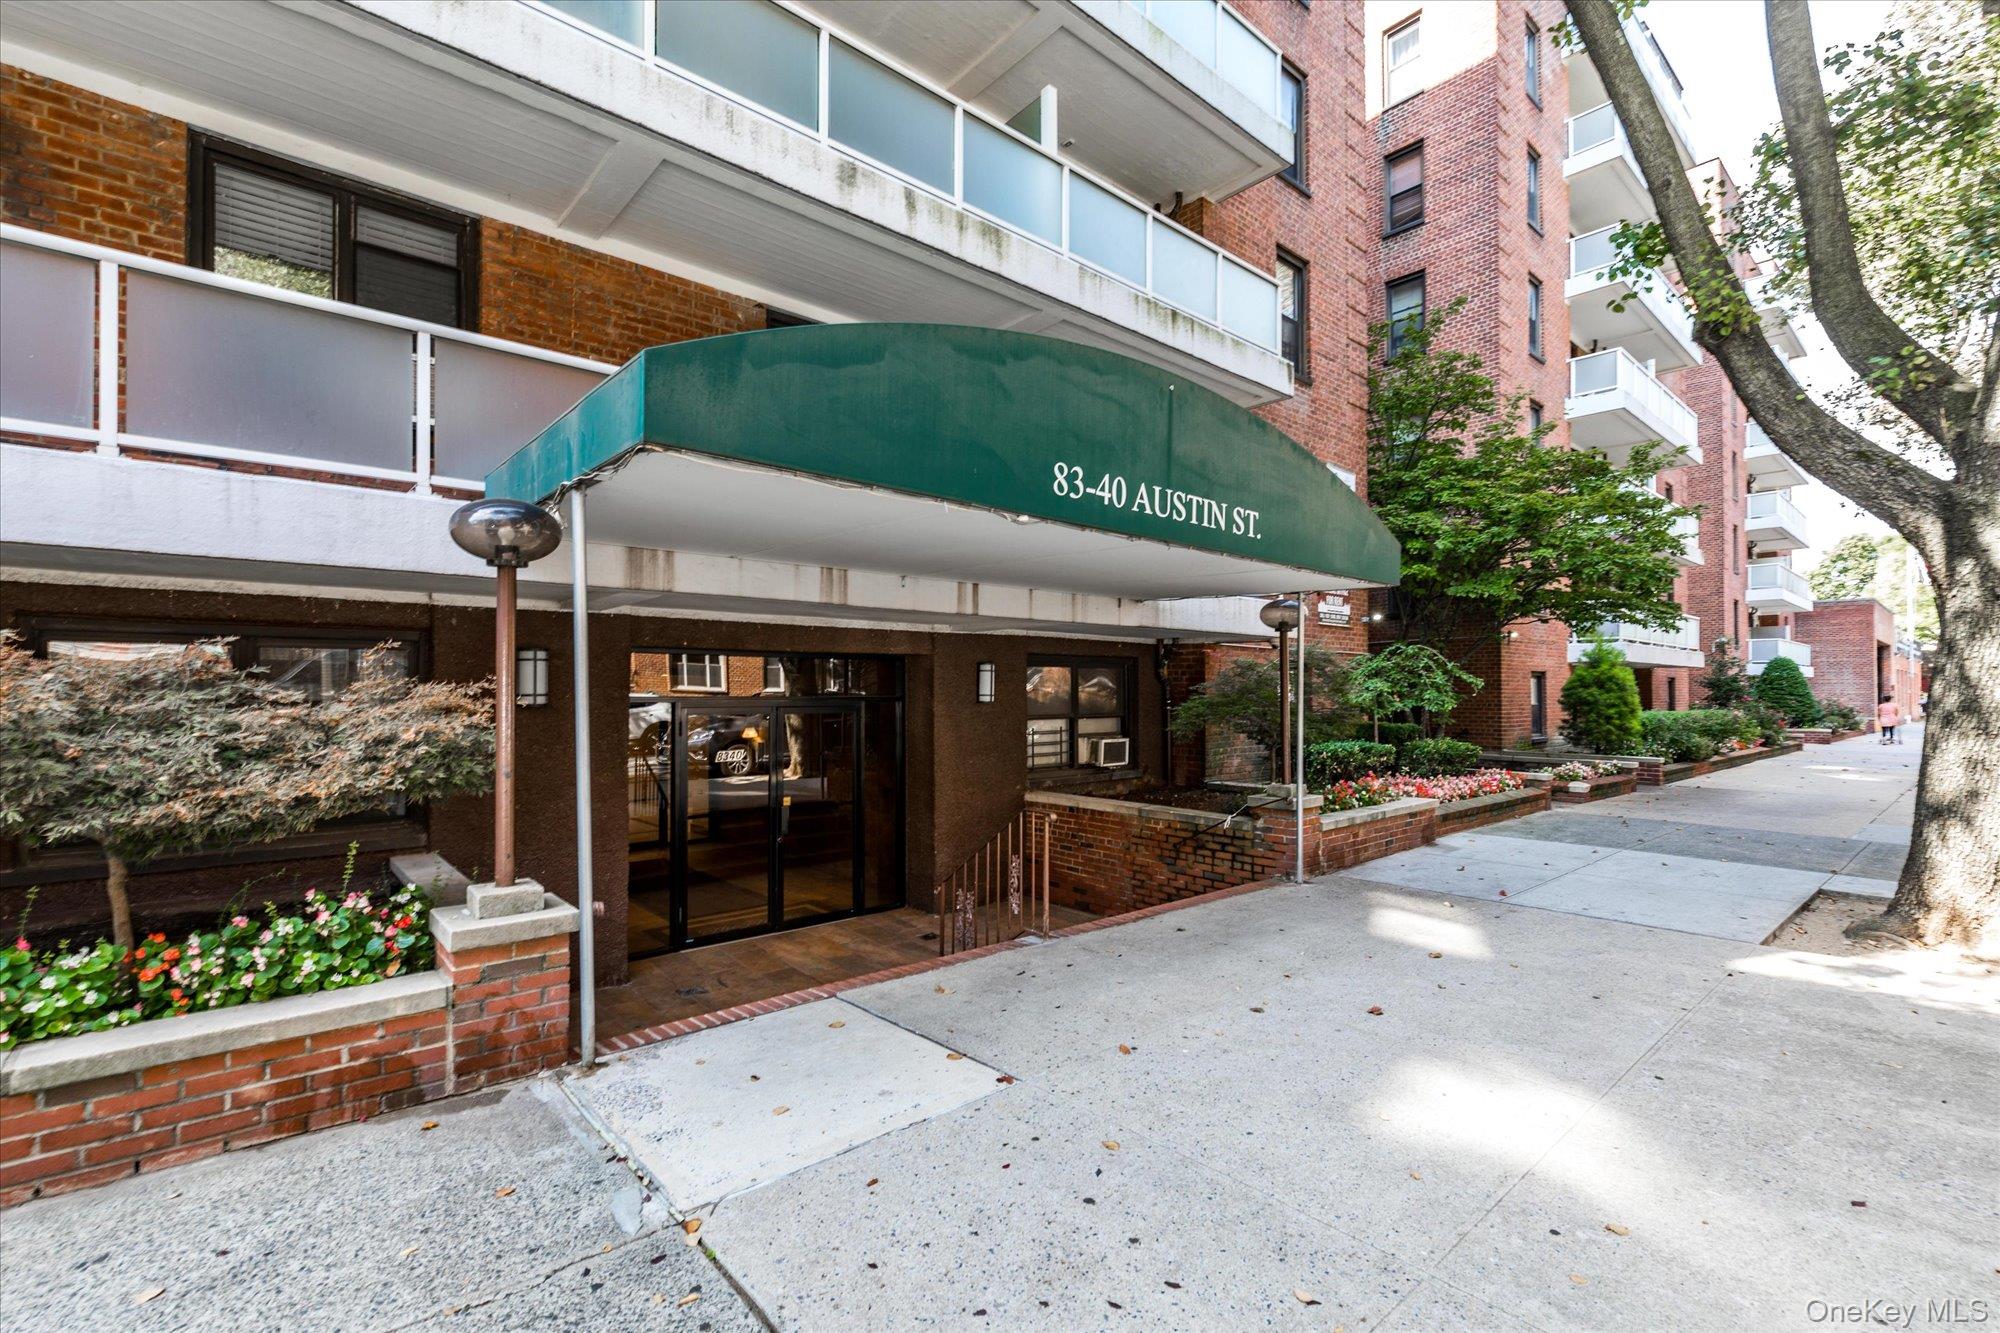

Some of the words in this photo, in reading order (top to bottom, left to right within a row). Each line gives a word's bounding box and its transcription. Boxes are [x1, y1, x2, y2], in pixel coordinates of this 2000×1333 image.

[1052, 461, 1127, 509] 83-40
[1131, 482, 1228, 532] AUSTIN
[1232, 506, 1262, 540] ST.
